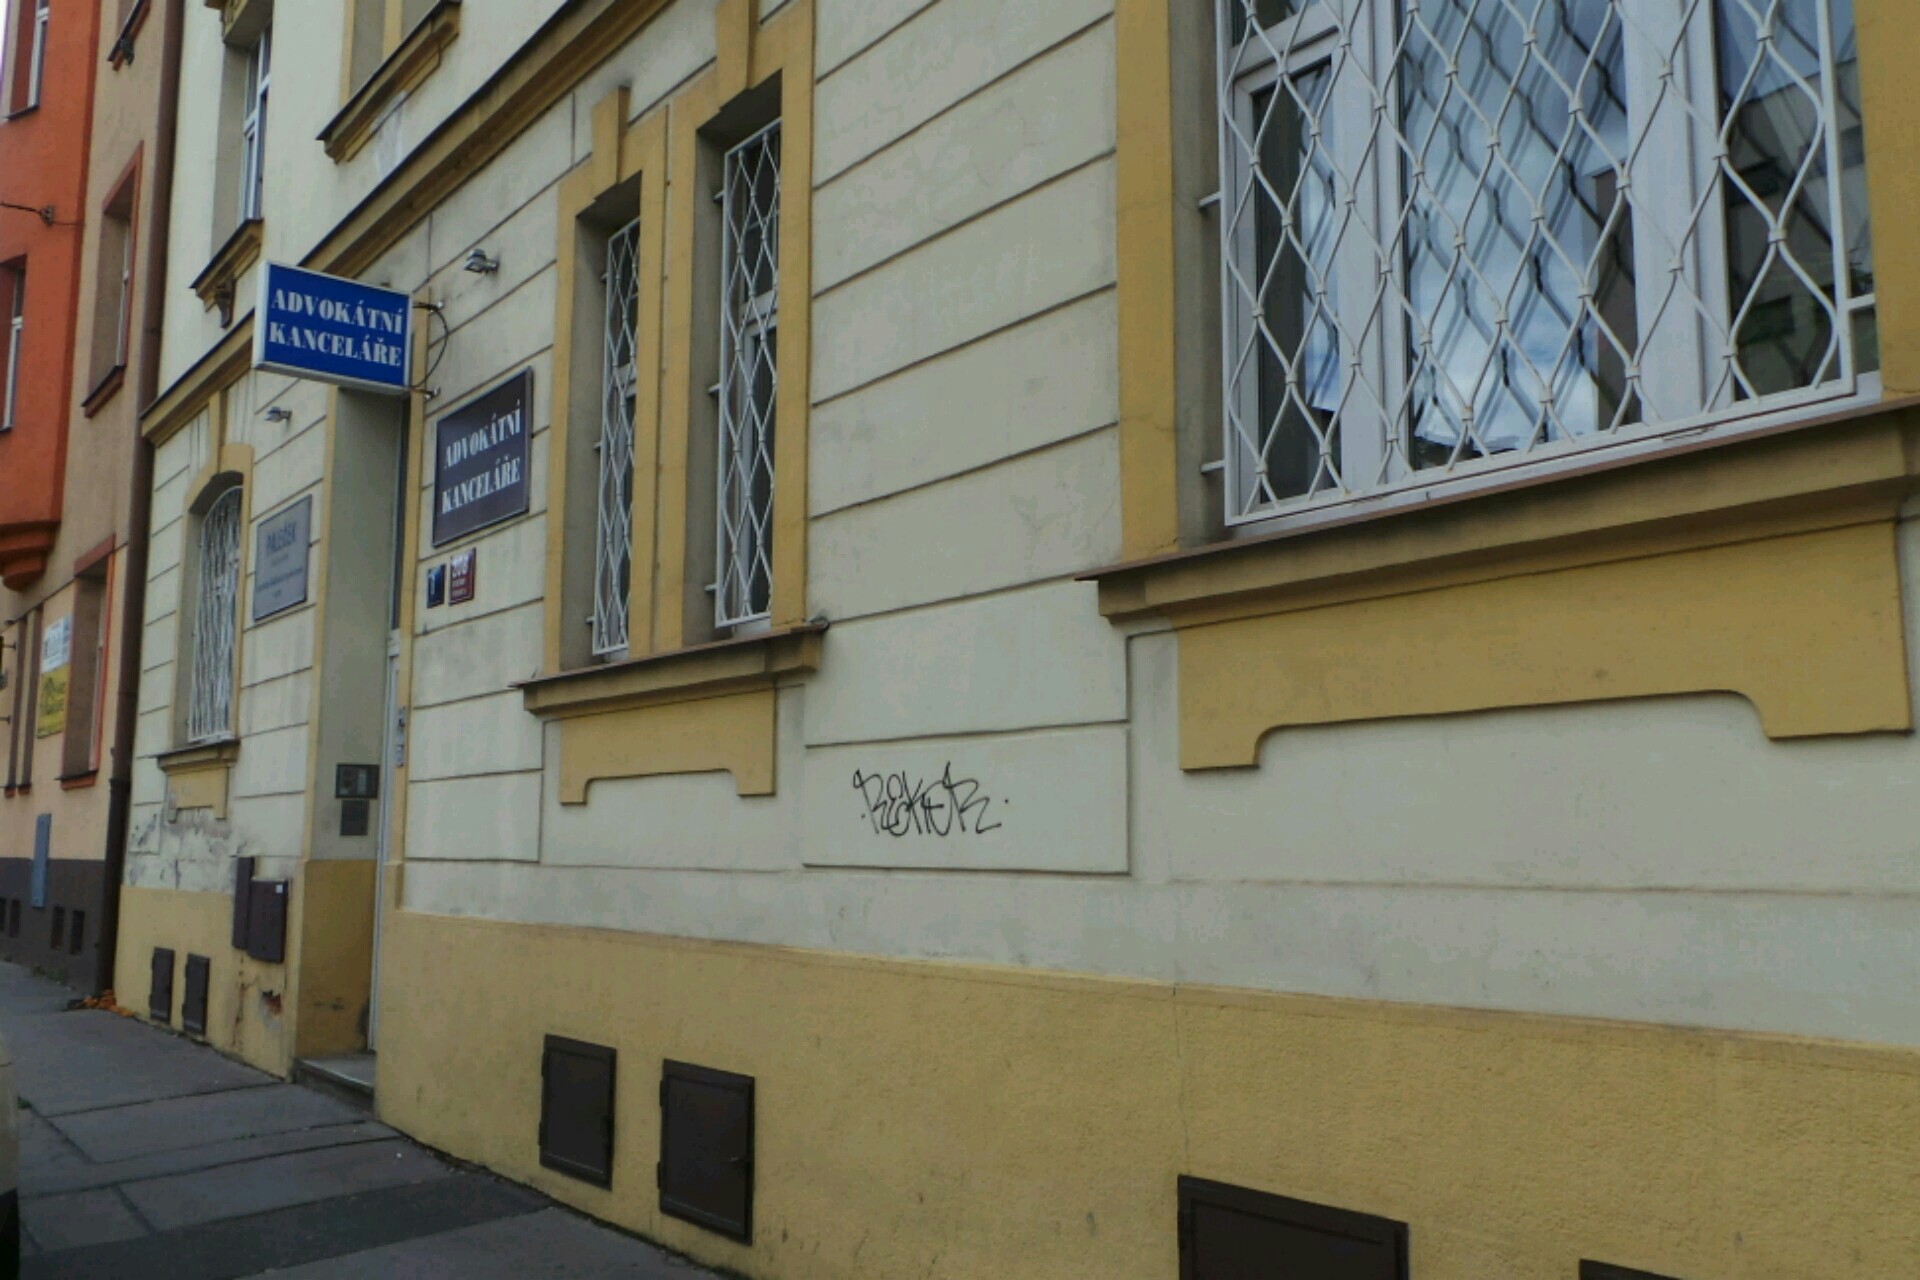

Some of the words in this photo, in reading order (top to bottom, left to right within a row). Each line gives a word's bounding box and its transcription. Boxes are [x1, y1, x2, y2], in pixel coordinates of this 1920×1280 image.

[271, 287, 403, 335] ADVOKÁTNÍ
[269, 321, 402, 368] KANCELÁŘE
[444, 398, 520, 470] ADVOKÁTNÍ
[442, 454, 520, 514] KANCELÁŘE
